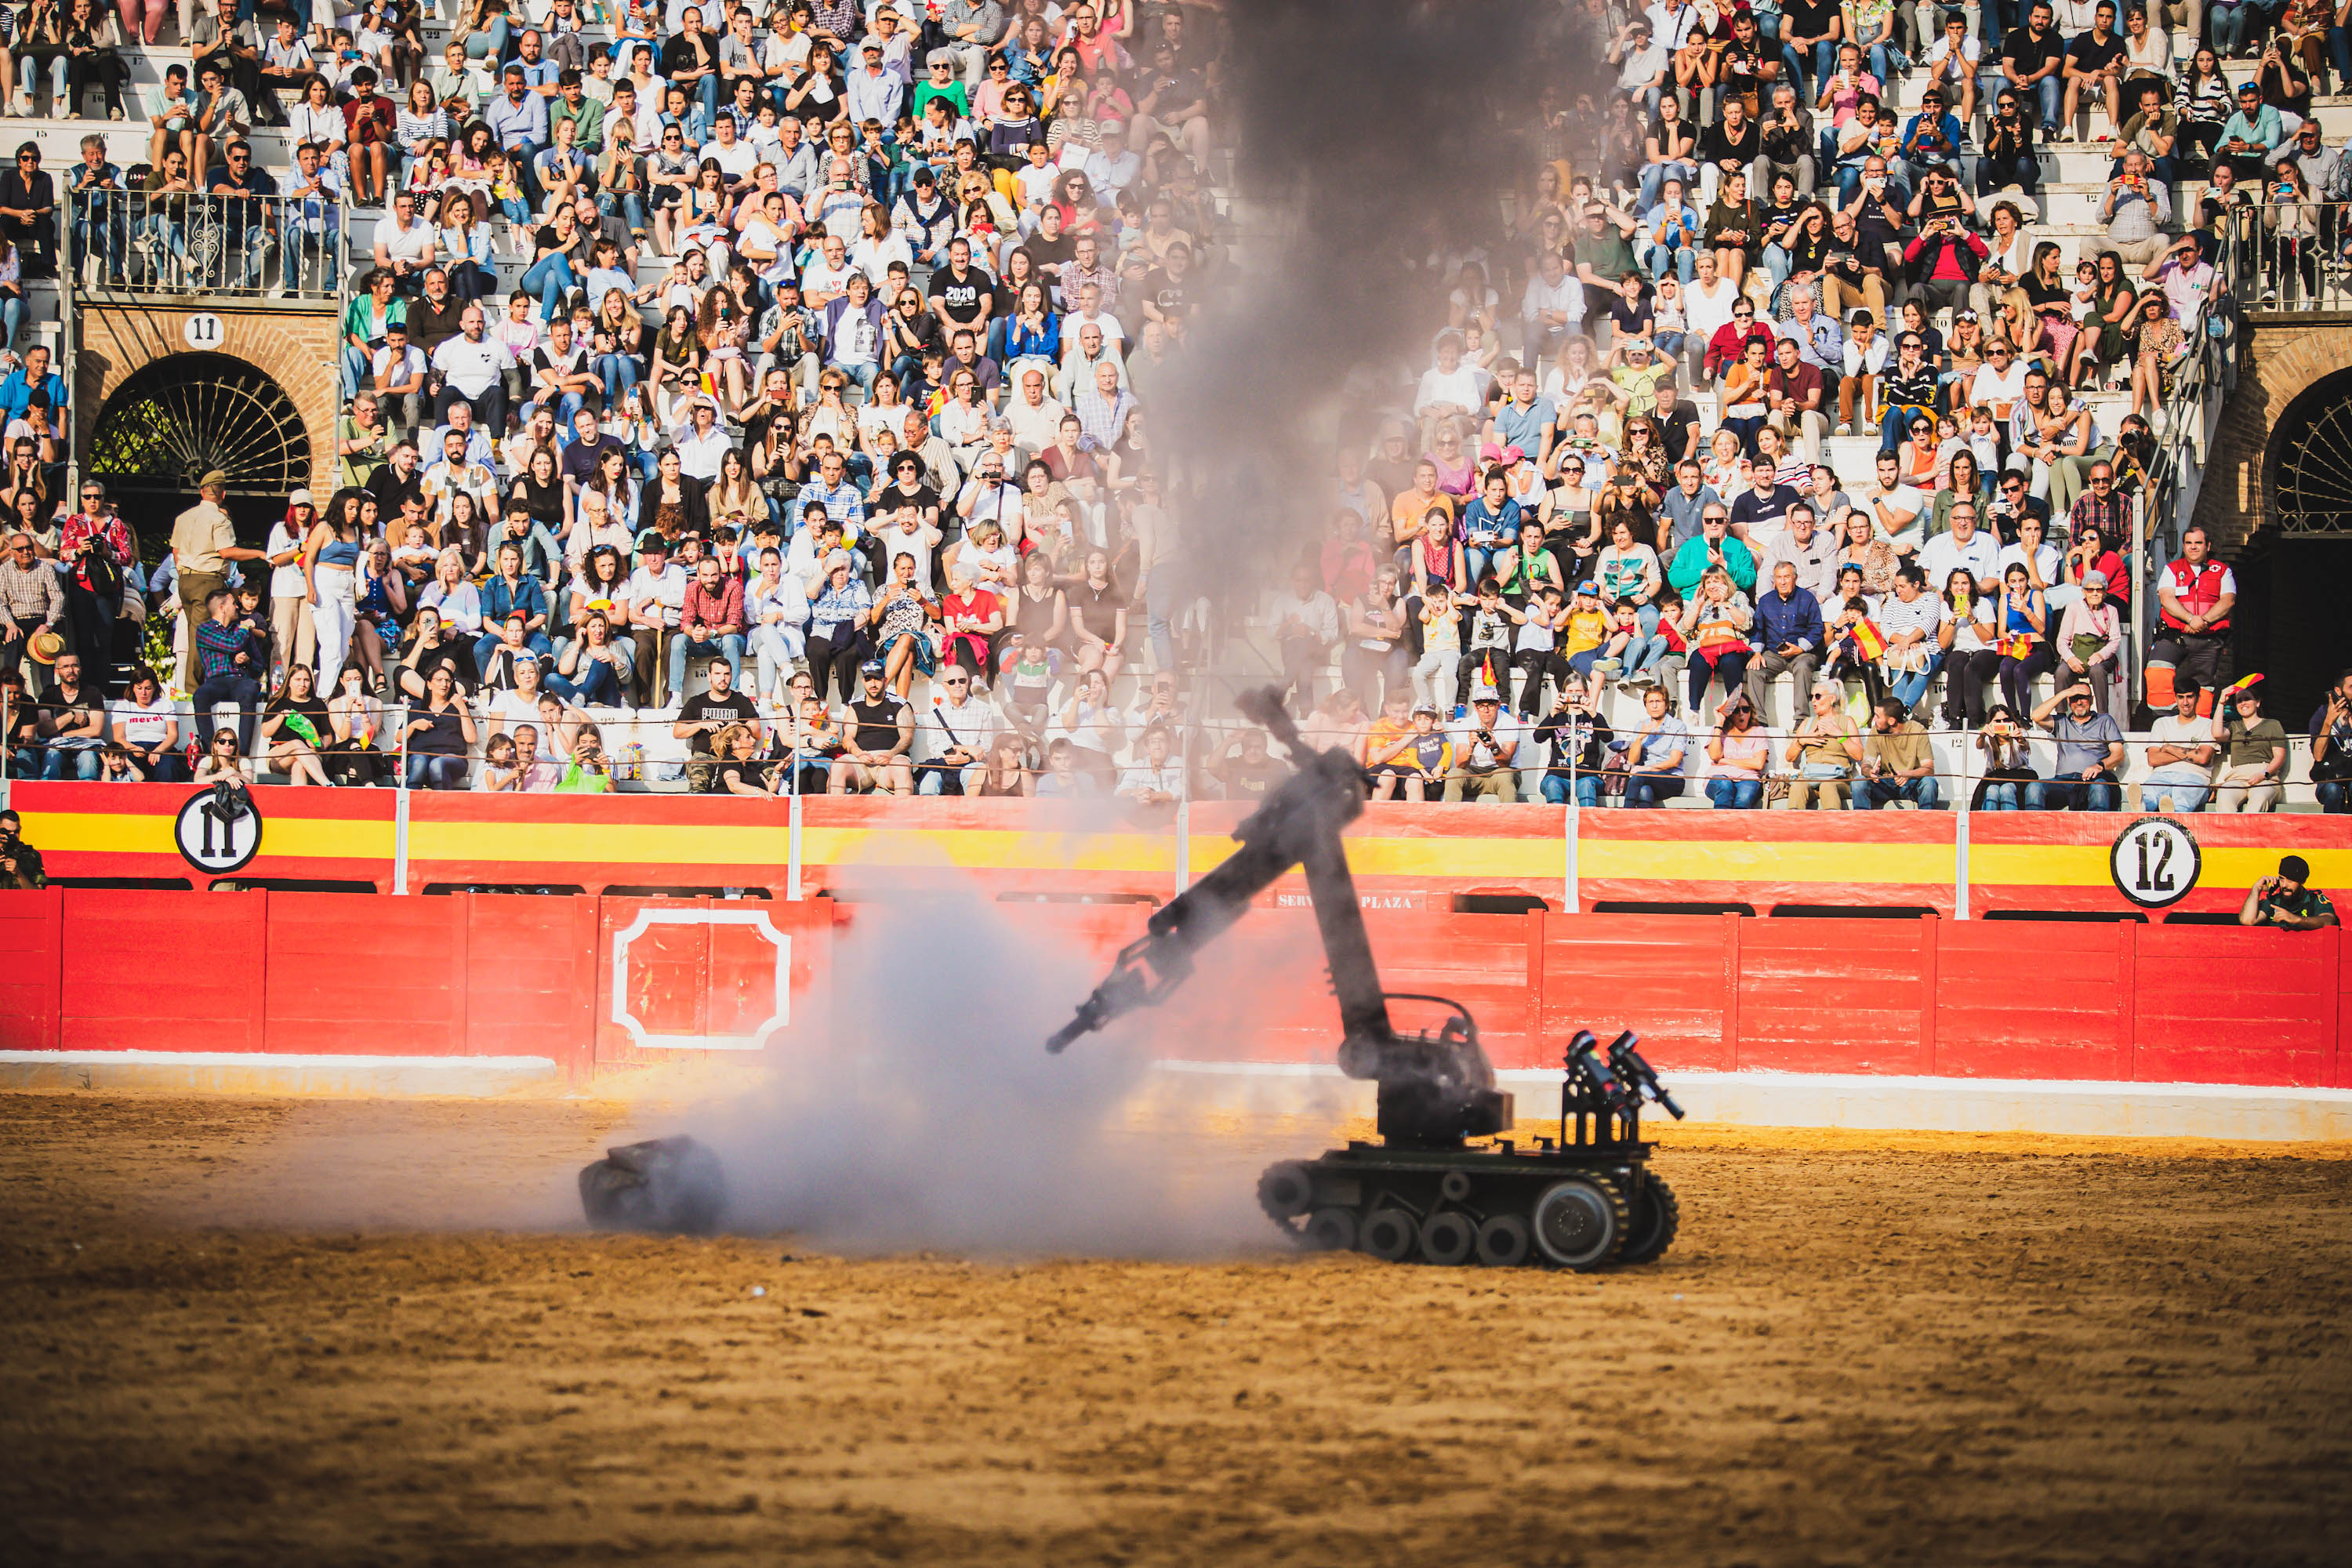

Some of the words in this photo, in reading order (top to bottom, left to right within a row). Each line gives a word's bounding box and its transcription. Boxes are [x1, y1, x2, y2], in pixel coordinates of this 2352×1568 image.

[426, 31, 441, 39] 22
[132, 57, 143, 66] 17
[36, 130, 48, 139] 15
[2086, 194, 2097, 202] 12
[504, 265, 515, 274] 17
[945, 285, 976, 303] 2020
[1936, 319, 1947, 328] 10
[194, 318, 215, 340] 11
[1703, 405, 1709, 414] 6
[1825, 448, 1831, 457] 8
[1933, 684, 1945, 694] 10
[1951, 739, 1962, 748] 12
[2292, 741, 2306, 751] 17
[200, 801, 238, 858] 11
[2134, 829, 2175, 891] 12
[1361, 896, 1412, 909] PLAZA
